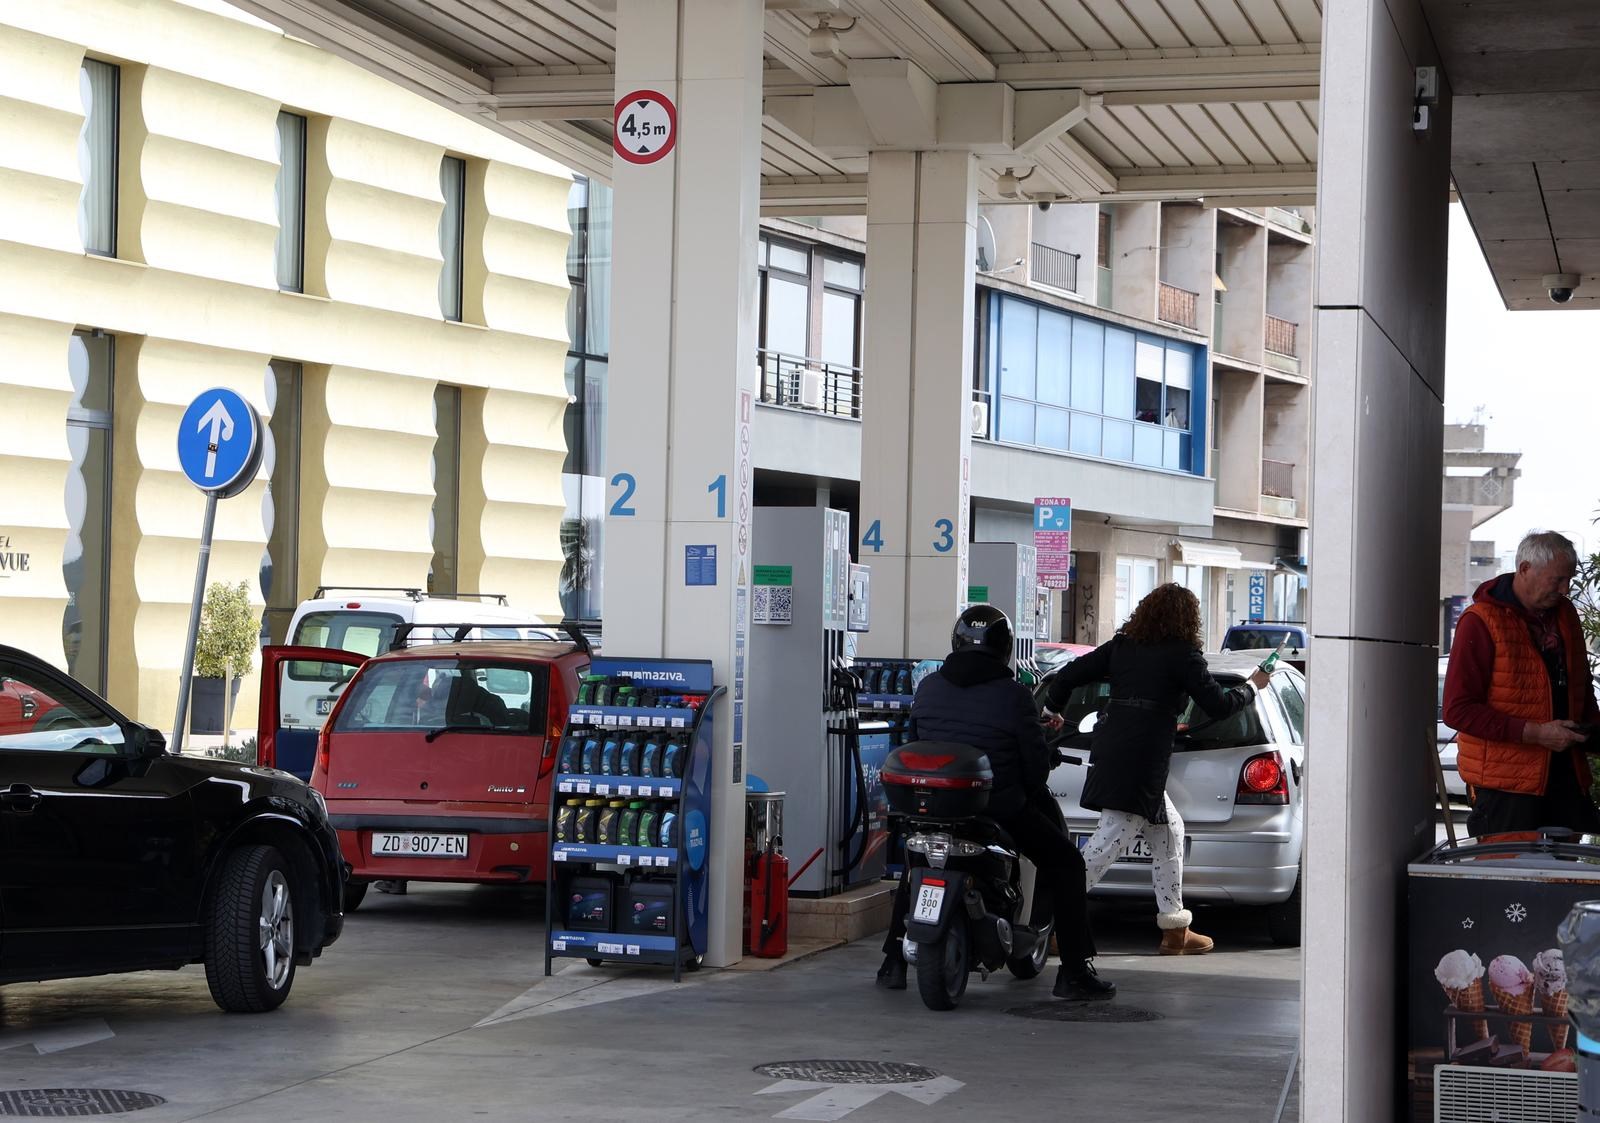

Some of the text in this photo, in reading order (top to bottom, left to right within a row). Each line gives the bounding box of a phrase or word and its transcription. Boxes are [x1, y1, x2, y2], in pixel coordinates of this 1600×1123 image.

[622, 113, 666, 139] 4,5 m
[610, 472, 636, 516] 2
[708, 475, 726, 518] 1
[1040, 498, 1059, 506] ZONA
[1039, 507, 1053, 527] P
[862, 519, 884, 552] 4
[933, 518, 954, 552] 3
[1251, 577, 1263, 614] MORE
[382, 835, 464, 853] ZD 907-EN
[921, 898, 938, 908] 300
[922, 889, 934, 898] SI
[921, 908, 932, 917] FI
